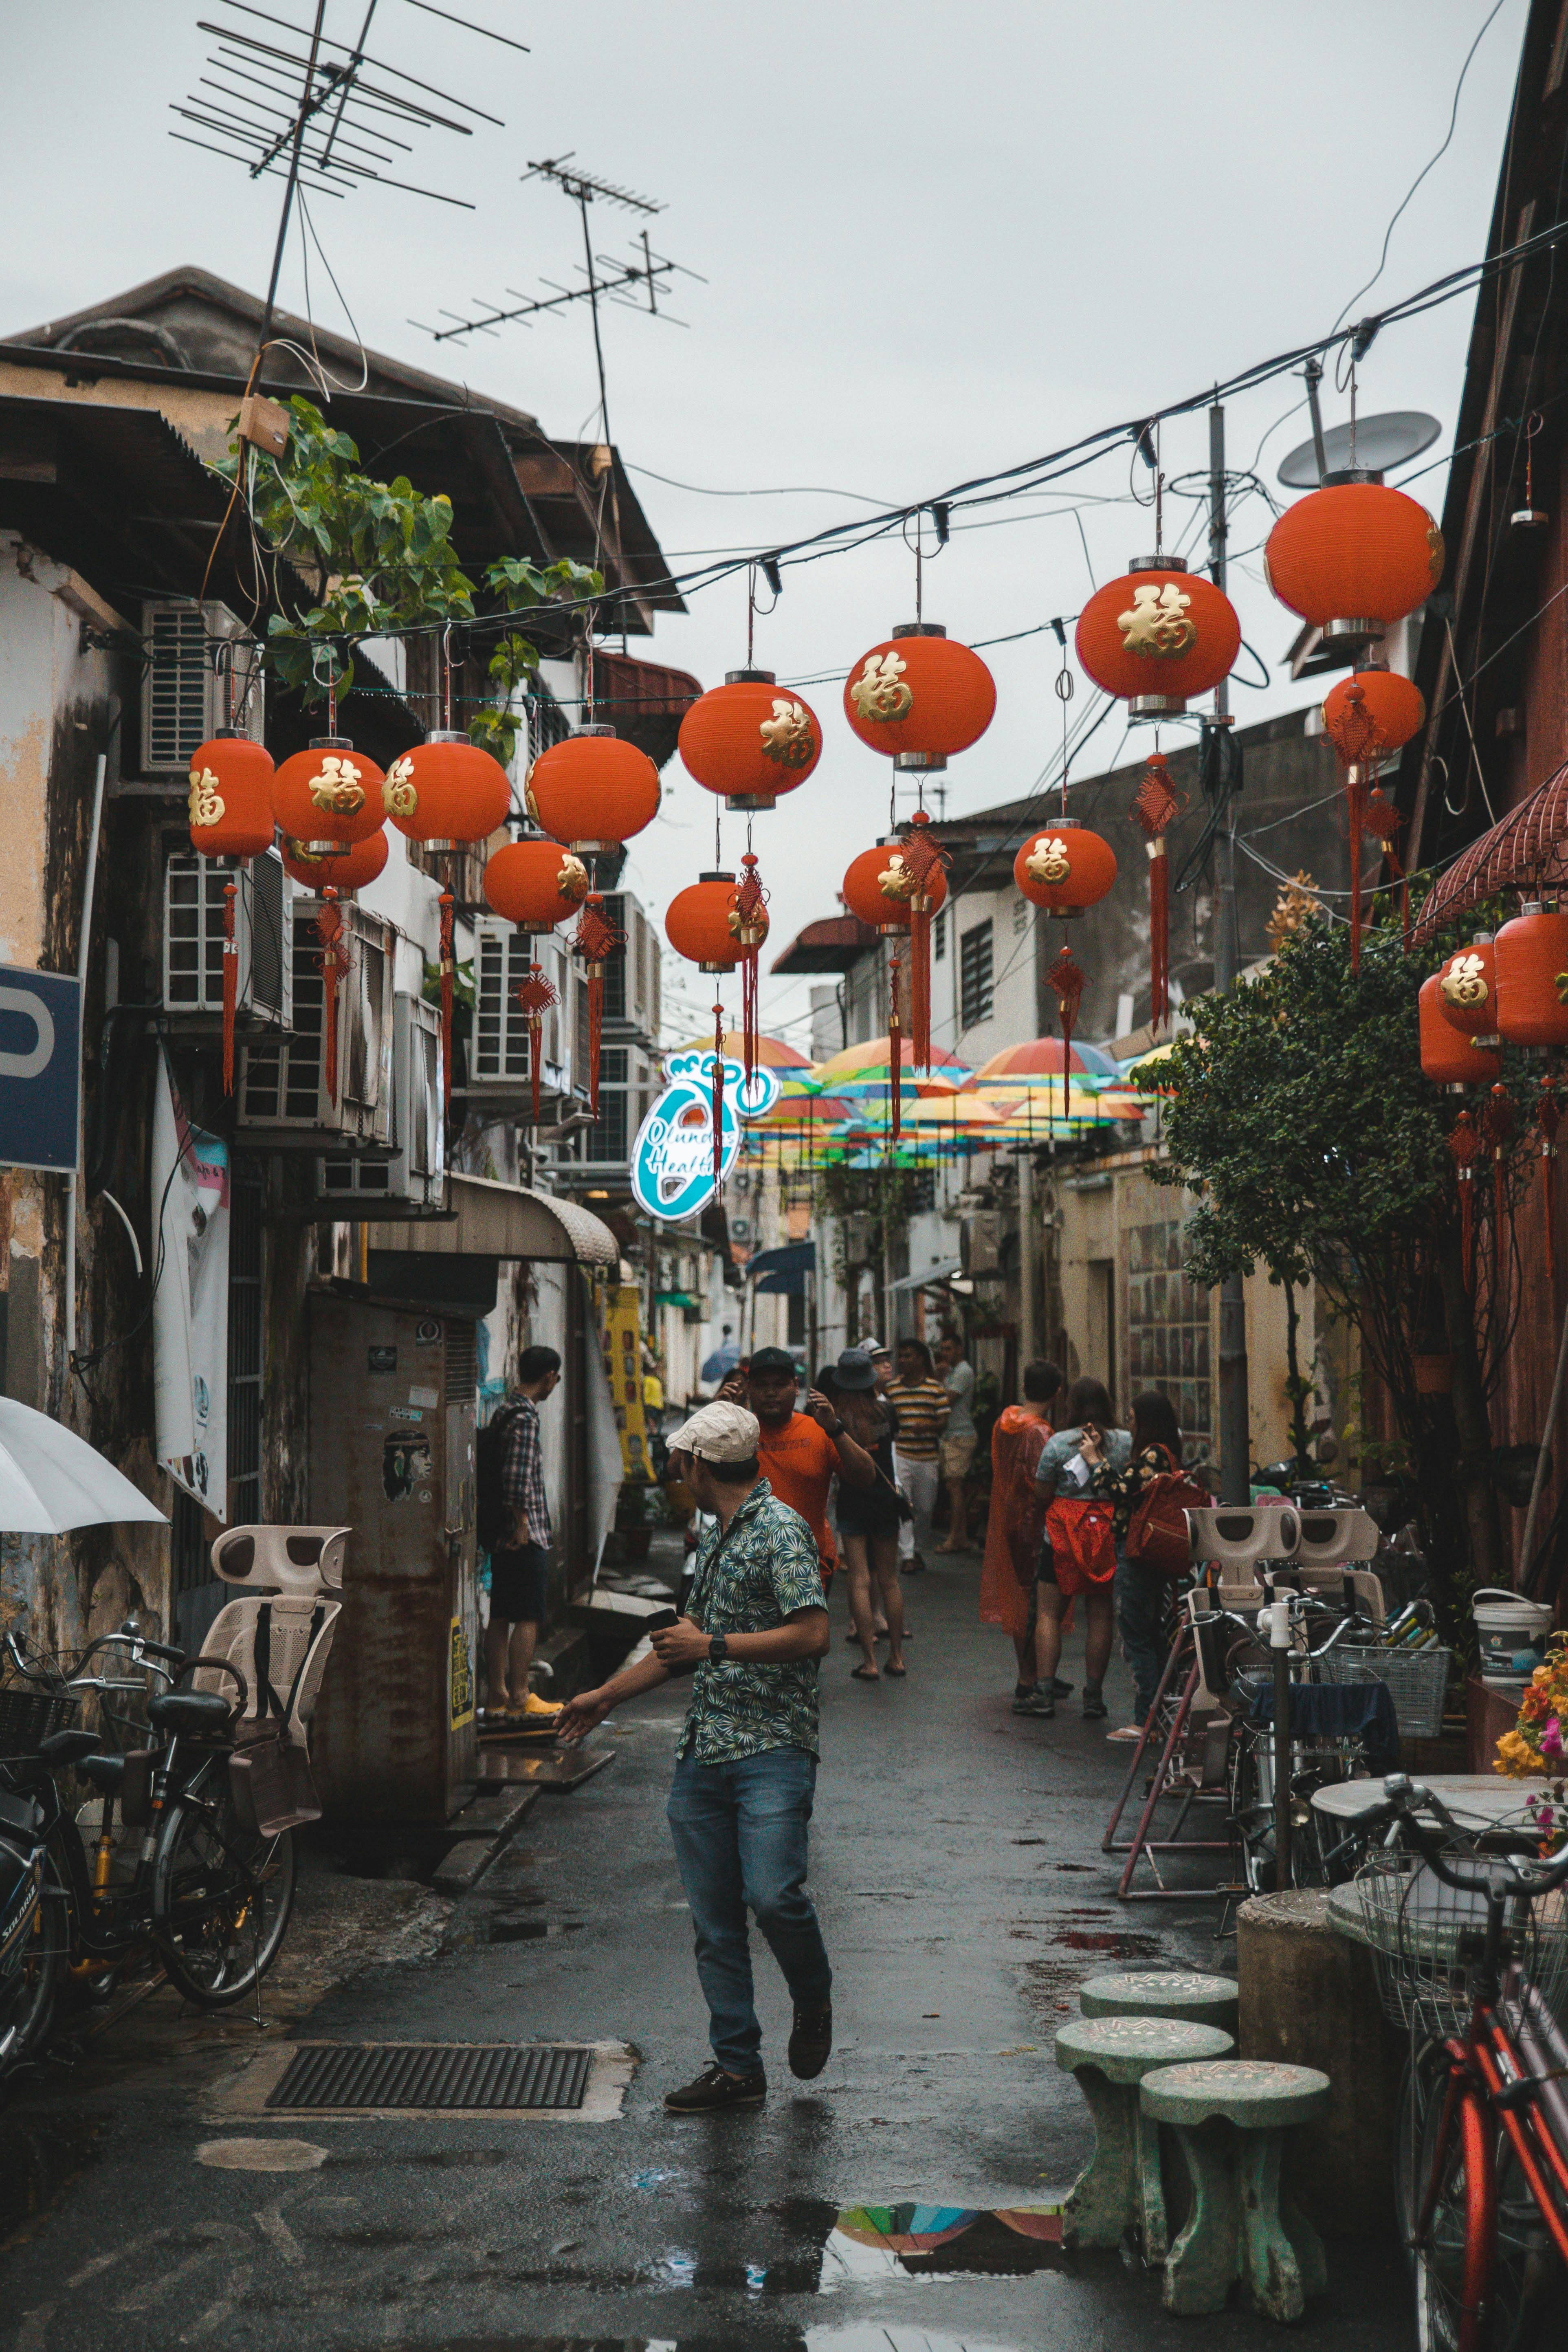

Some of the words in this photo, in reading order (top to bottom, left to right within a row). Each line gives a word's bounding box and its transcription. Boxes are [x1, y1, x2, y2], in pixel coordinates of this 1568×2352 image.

[1117, 583, 1196, 659] 福
[850, 651, 913, 722] 福
[759, 700, 815, 768] 福
[188, 768, 225, 826] 福
[309, 757, 365, 815] 福
[381, 757, 418, 816] 福
[1025, 838, 1071, 884] 福
[1440, 954, 1488, 1009] 福
[2, 1885, 36, 1943] SOLARIZ
